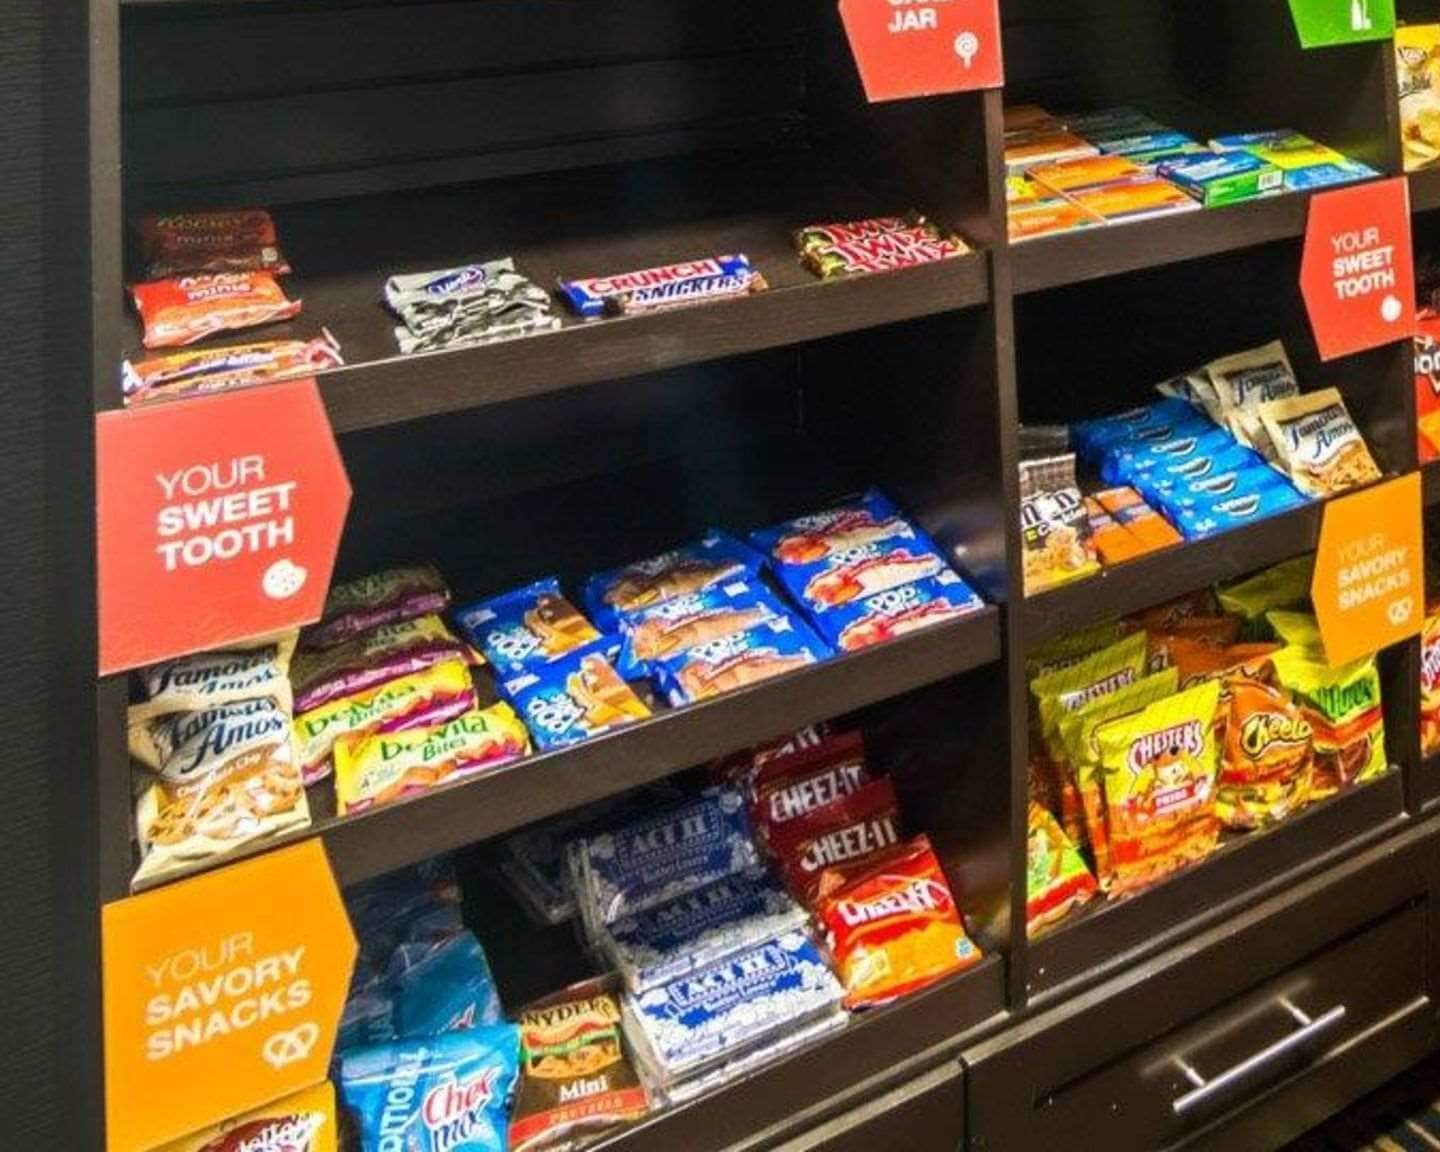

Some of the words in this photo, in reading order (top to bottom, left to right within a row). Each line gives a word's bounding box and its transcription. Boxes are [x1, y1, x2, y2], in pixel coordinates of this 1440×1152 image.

[888, 8, 937, 33] JAR
[1332, 227, 1379, 250] YOUR
[586, 261, 715, 296] CRUNCH
[1332, 247, 1395, 277] SWEET
[636, 274, 746, 304] SNICKERS
[1334, 271, 1396, 300] TOOTH
[156, 454, 267, 500] YOUR
[156, 483, 296, 537] SWEET
[157, 516, 295, 571] TOOTH
[1337, 533, 1384, 560] YOUR
[1337, 548, 1408, 585] SAVORY
[1338, 570, 1411, 607] SNACKS
[181, 717, 283, 774] Amos
[1242, 712, 1313, 756] Cheeto
[770, 764, 864, 823] CHEEZ-IT
[800, 817, 898, 873] CHEEZ-IT
[144, 931, 254, 986] YOUR
[145, 945, 306, 1027] SAVORY
[145, 980, 312, 1062] SNACKS
[559, 1076, 609, 1103] Mini
